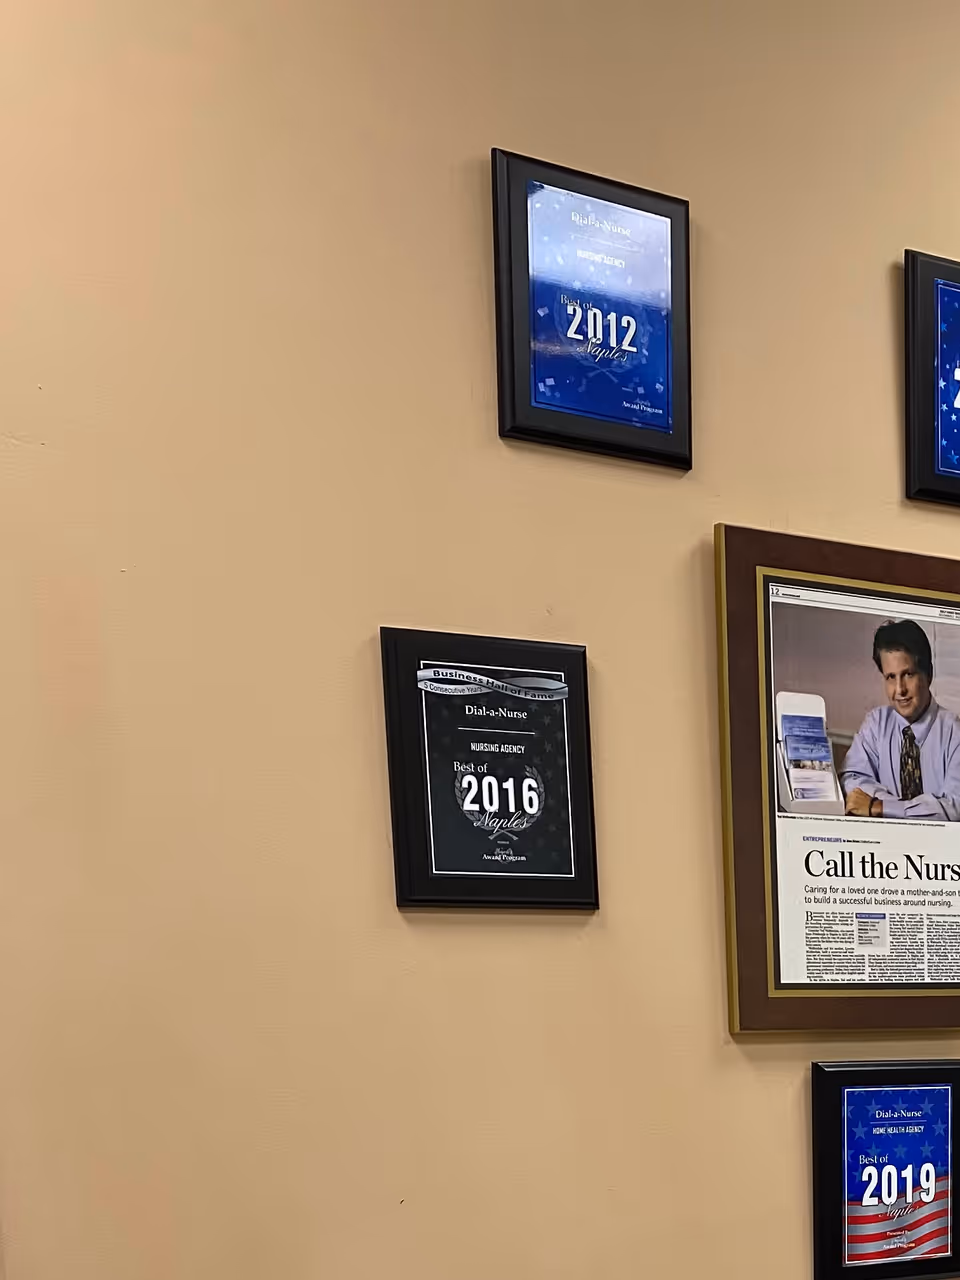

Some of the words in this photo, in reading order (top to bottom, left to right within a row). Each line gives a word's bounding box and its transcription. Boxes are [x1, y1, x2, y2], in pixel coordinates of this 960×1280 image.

[566, 303, 637, 352] 2012
[576, 337, 627, 363] Naples
[771, 587, 780, 596] 12
[433, 670, 483, 684] Business
[486, 680, 508, 691] Hall
[429, 684, 466, 694] Consecutive
[465, 704, 527, 720] Dial-a-Nurse
[470, 742, 499, 753] NURSING
[500, 744, 525, 754] AGENCY
[453, 761, 475, 772] Best
[477, 762, 488, 773] of
[461, 774, 539, 815] 2016
[473, 809, 528, 834] Naples
[804, 849, 855, 879] Call
[859, 852, 898, 879] the
[804, 885, 828, 894] Caring
[829, 886, 839, 894] for
[847, 886, 865, 895] loved
[881, 886, 899, 895] drove
[907, 888, 957, 897] mother-and-son
[805, 896, 812, 904] to
[813, 896, 831, 904] build
[839, 897, 873, 905] successful
[874, 897, 901, 906] business
[903, 898, 926, 906] around
[927, 899, 953, 908] nursing.
[875, 1109, 922, 1118] Dial-a-Nurse
[873, 1127, 886, 1135] HOME
[887, 1126, 905, 1134] HEALTH
[906, 1125, 925, 1133] AGENCY
[859, 1155, 878, 1164] Best
[879, 1153, 889, 1163] of
[861, 1162, 936, 1207] 2019
